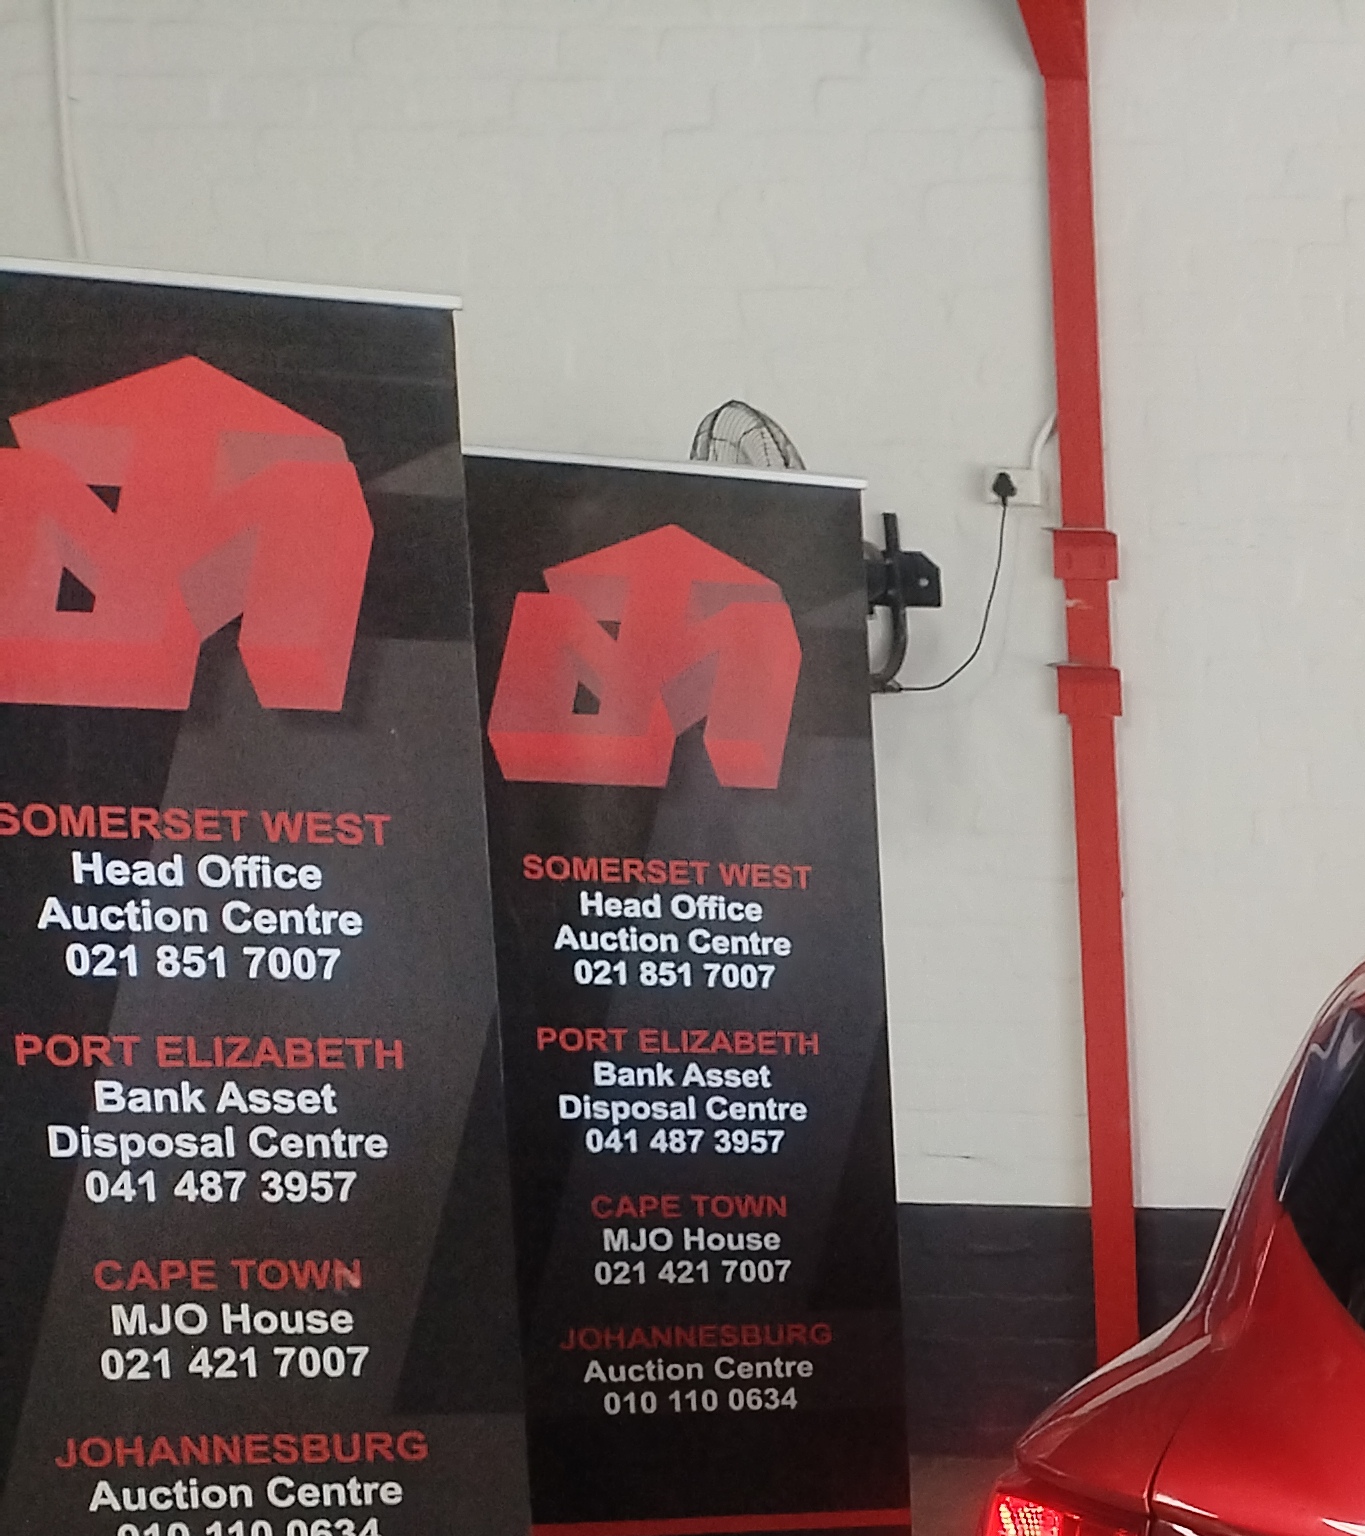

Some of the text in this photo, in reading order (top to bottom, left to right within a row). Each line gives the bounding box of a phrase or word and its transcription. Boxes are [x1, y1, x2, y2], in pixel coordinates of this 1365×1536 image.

[0, 802, 391, 845] SOMERSET WEST
[72, 851, 322, 889] Head Office
[523, 854, 811, 888] SOMERSET WEST
[38, 897, 362, 935] Auction Centre
[581, 891, 762, 921] Head Office
[555, 925, 791, 956] Auction Centre
[66, 943, 340, 979] 021 851 7007
[574, 959, 775, 988] 021 851 7007
[15, 1033, 403, 1069] PORT ELIZABETH
[537, 1027, 819, 1054] PORT ELIZABETH
[594, 1061, 771, 1088] Bank Asset
[95, 1080, 337, 1114] Bank Asset
[559, 1095, 807, 1125] Disposal Centre
[48, 1125, 388, 1165] Disposal Centre
[586, 1128, 784, 1153] 041 487 3957
[86, 1170, 356, 1202] 041 487 3957
[592, 1194, 786, 1218] CAPE TOWN
[603, 1228, 780, 1251] MJO House
[94, 1259, 361, 1291] CAPE TOWN
[595, 1260, 791, 1285] 021 421 7007
[112, 1303, 353, 1335] MJO House
[561, 1323, 832, 1350] JOHANNESBURG
[101, 1346, 369, 1379] 021 421 7007
[584, 1357, 813, 1383] Auction Centre
[604, 1387, 797, 1414] 010 110 0634
[56, 1431, 428, 1468] JOHANNESBURG
[89, 1476, 402, 1511] Auction Centre
